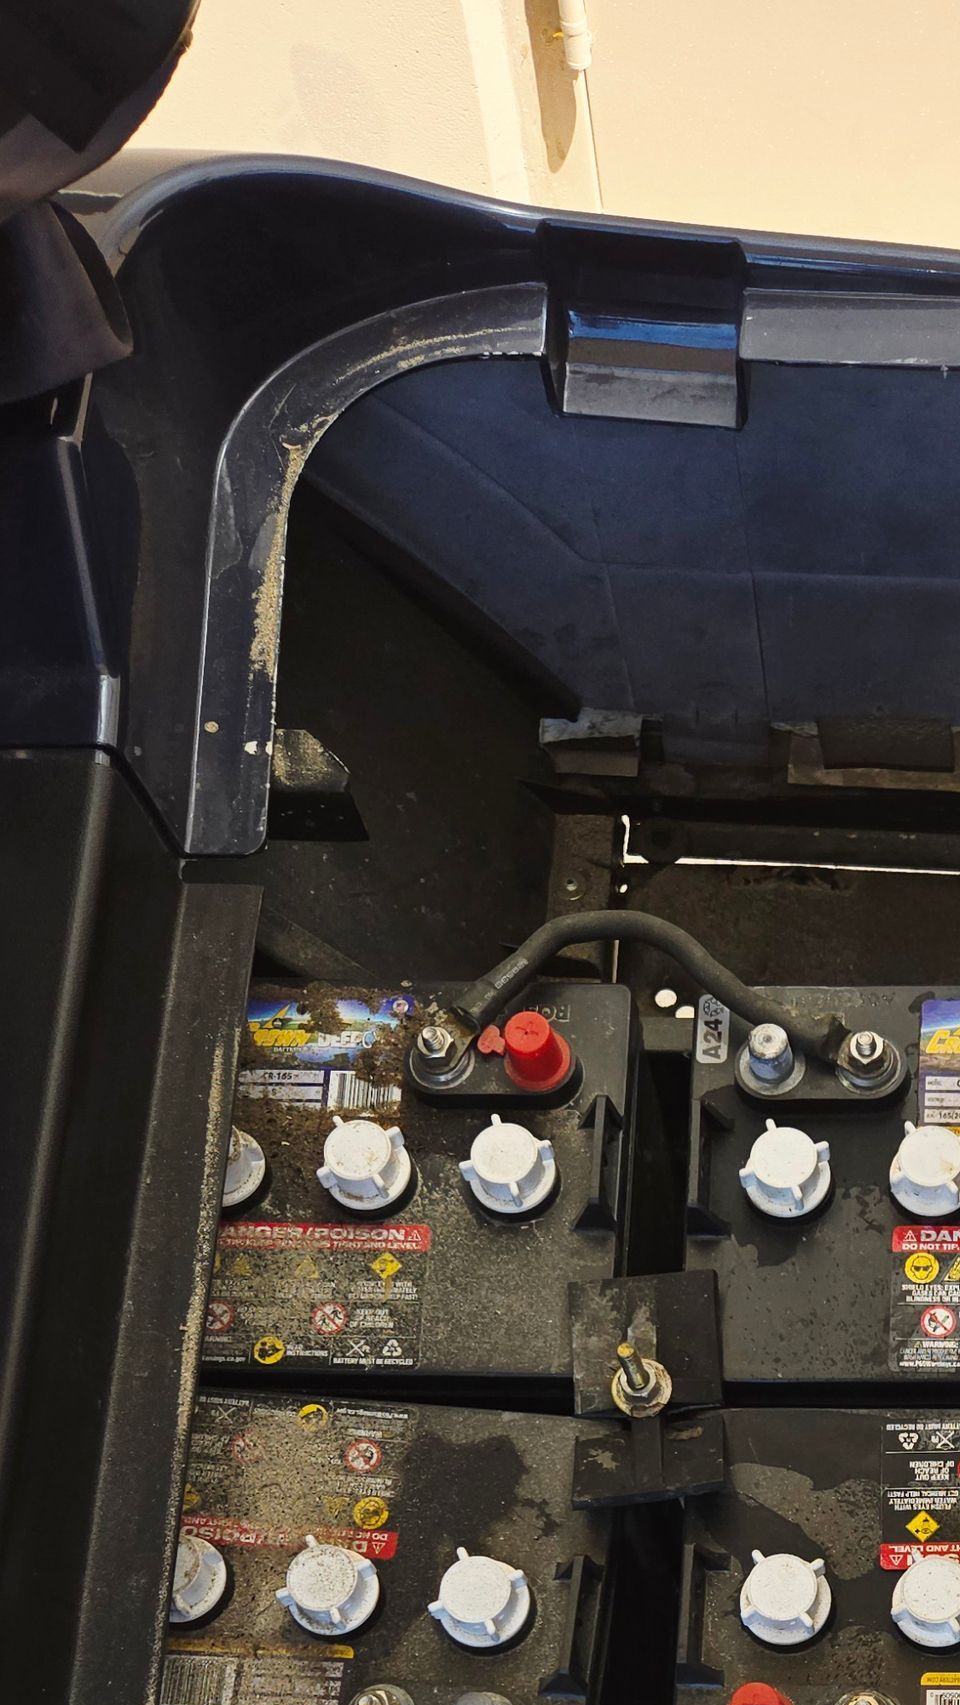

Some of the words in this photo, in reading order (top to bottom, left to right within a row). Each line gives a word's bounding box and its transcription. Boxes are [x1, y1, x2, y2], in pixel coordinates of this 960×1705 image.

[702, 1018, 723, 1060] A24
[909, 1460, 944, 1468] CHILDREN
[945, 1460, 954, 1468] OF
